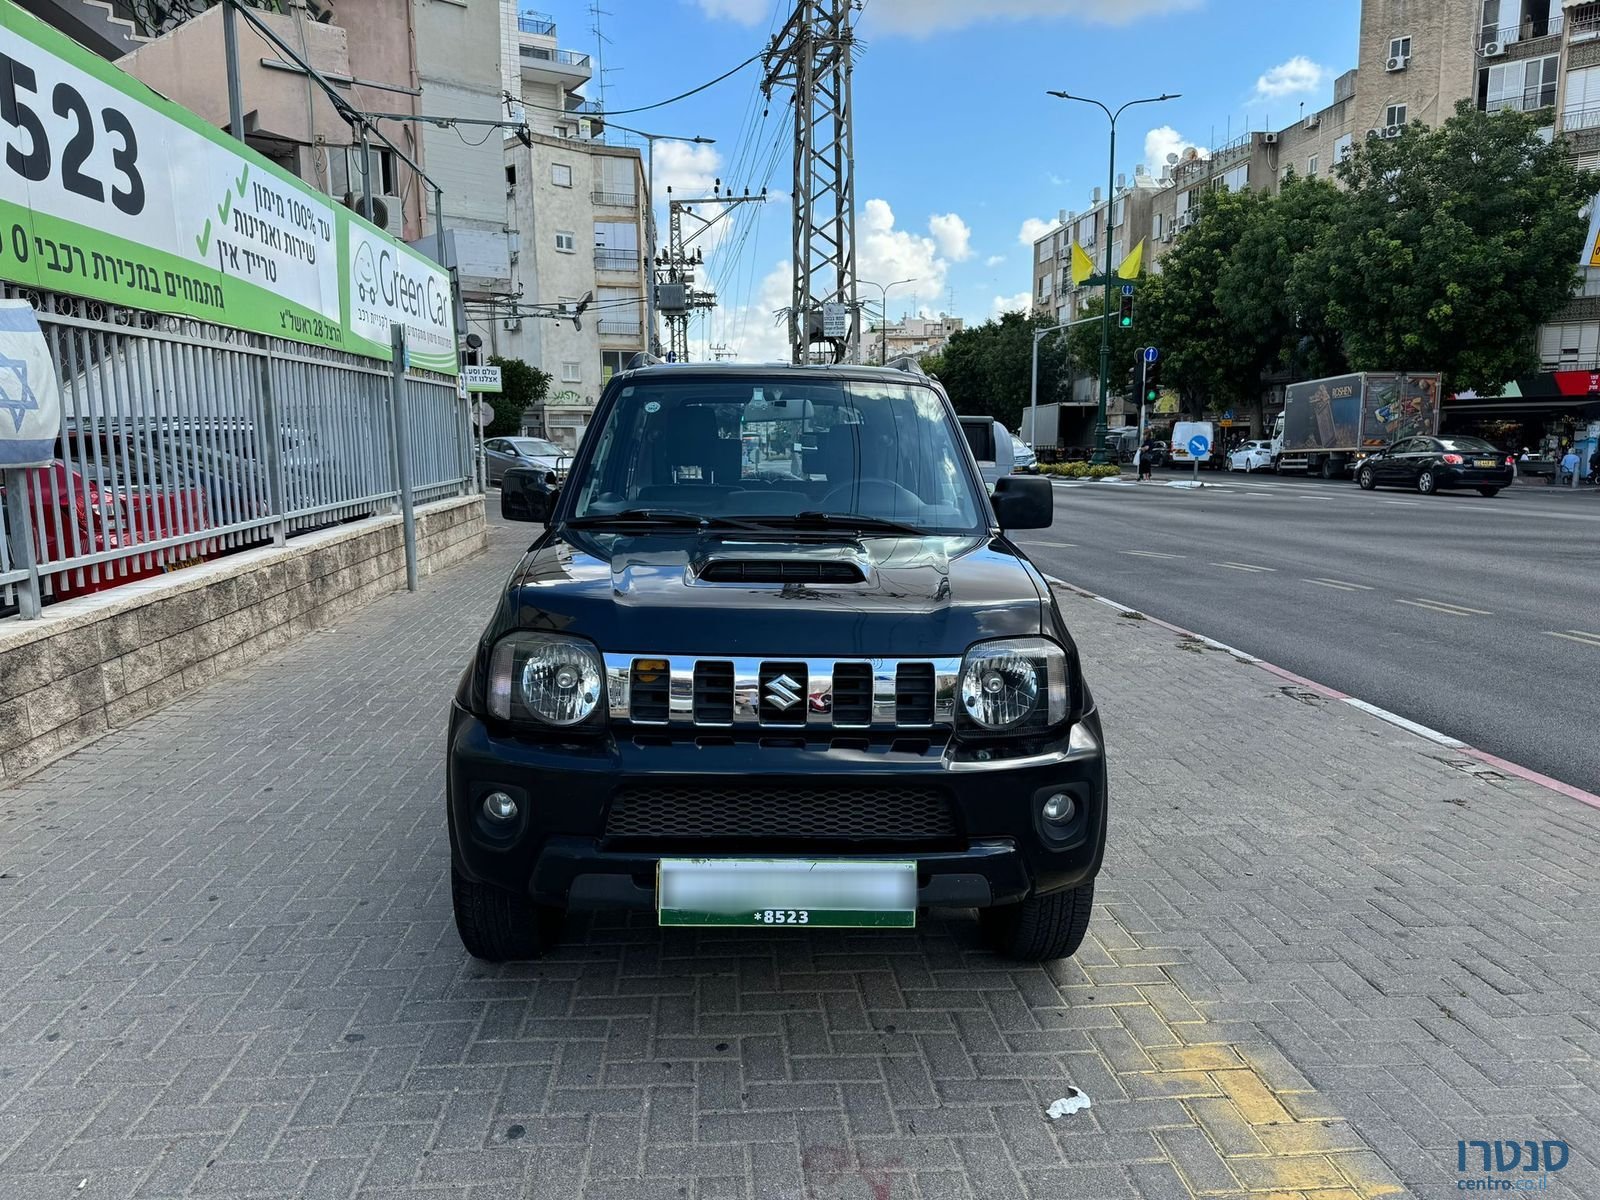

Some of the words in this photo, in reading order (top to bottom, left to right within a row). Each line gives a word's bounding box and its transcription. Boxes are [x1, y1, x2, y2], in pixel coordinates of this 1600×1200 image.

[252, 181, 285, 219] מימון
[287, 198, 316, 235] 100%
[11, 223, 29, 263] 0
[233, 208, 282, 251] ואמינות
[317, 218, 331, 242] עד
[34, 237, 87, 278] רכבי
[217, 239, 240, 273] אין
[242, 249, 277, 283] טרייד
[284, 232, 316, 265] שירות
[91, 251, 161, 294] במכירת
[164, 271, 224, 309] מתמחים
[379, 249, 426, 320] Green
[427, 275, 448, 328] Car
[313, 318, 323, 338] 28
[324, 320, 342, 343] הרצל
[479, 375, 498, 383] אצלנו
[481, 368, 497, 376] שלם
